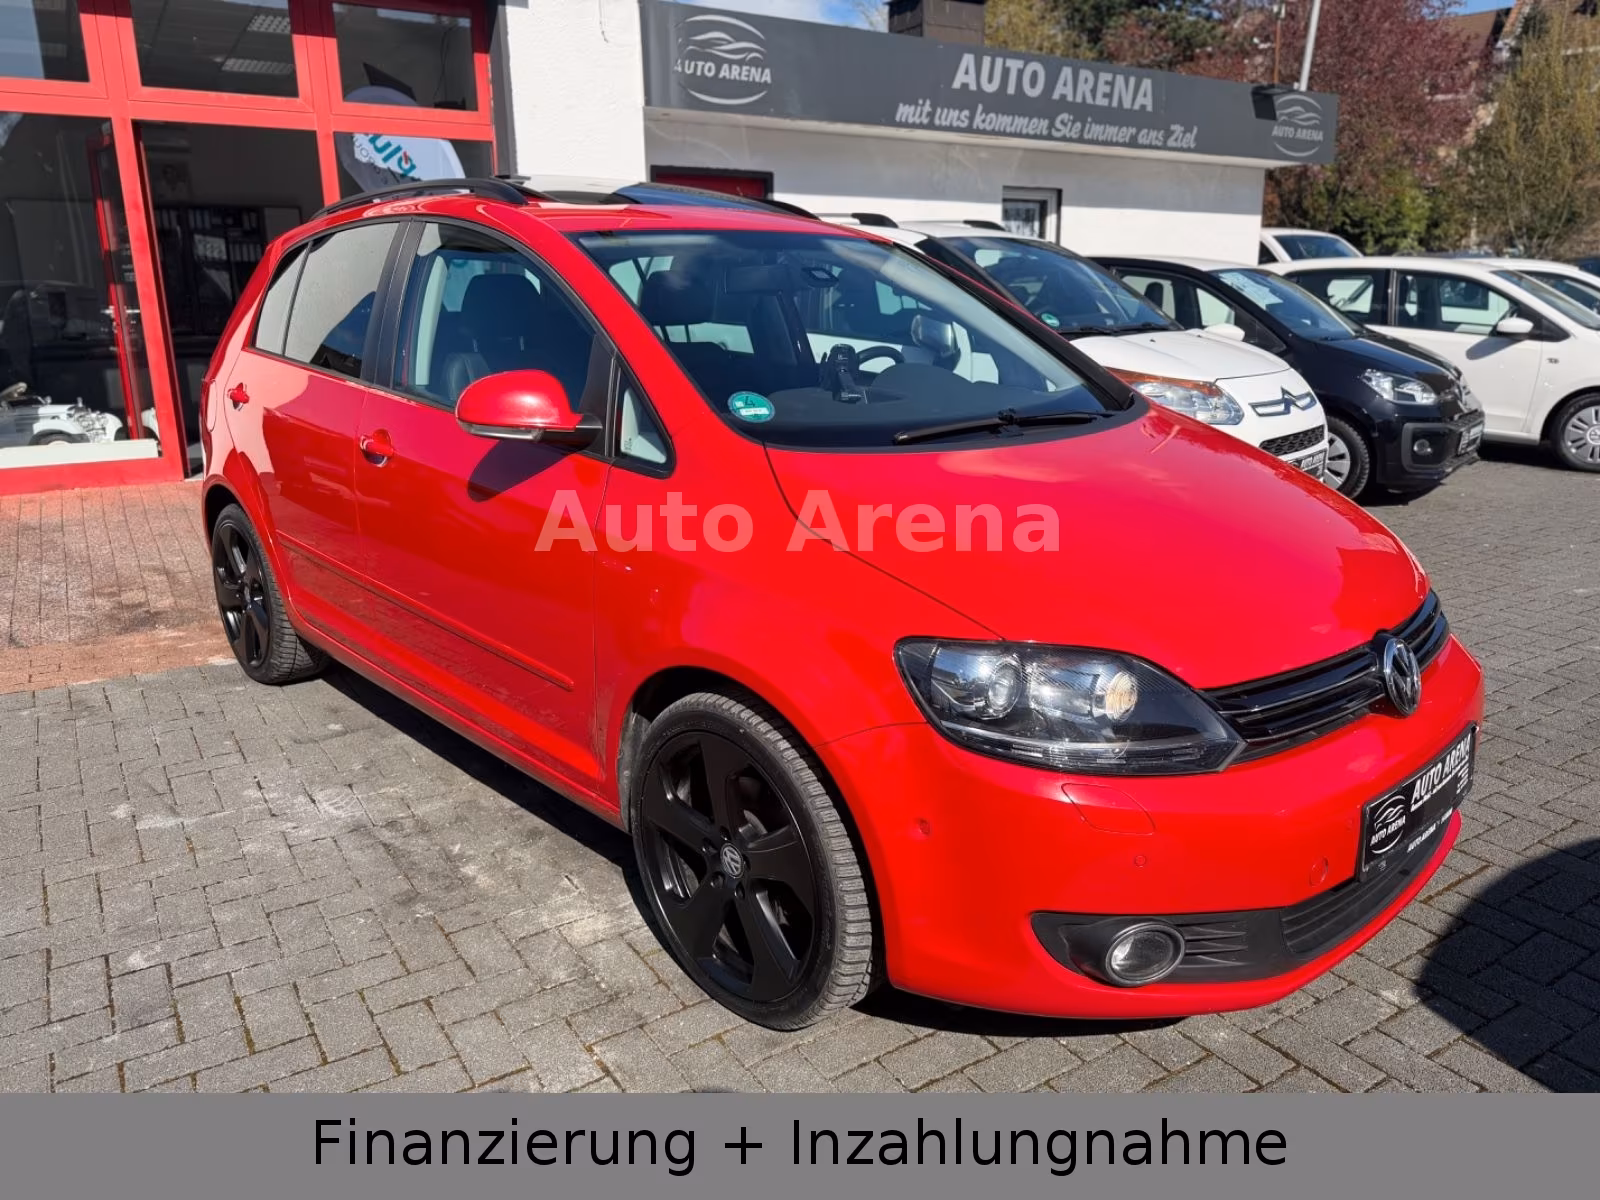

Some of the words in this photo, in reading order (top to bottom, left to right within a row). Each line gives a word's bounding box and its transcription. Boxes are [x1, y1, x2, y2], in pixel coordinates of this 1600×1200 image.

[718, 63, 772, 84] ARENA
[951, 52, 1045, 98] AUTO
[1051, 66, 1154, 112] ARENA
[895, 98, 932, 125] mit
[934, 107, 970, 128] uns
[972, 103, 1049, 136] kommen
[1051, 112, 1082, 139] Sie
[1083, 116, 1136, 144] immer
[1137, 128, 1164, 146] ans
[1166, 123, 1198, 149] Ziel
[1271, 125, 1295, 138] AUTO
[1295, 128, 1324, 141] ARENA
[1410, 762, 1442, 804] AUTO
[1442, 733, 1470, 779] ARENA
